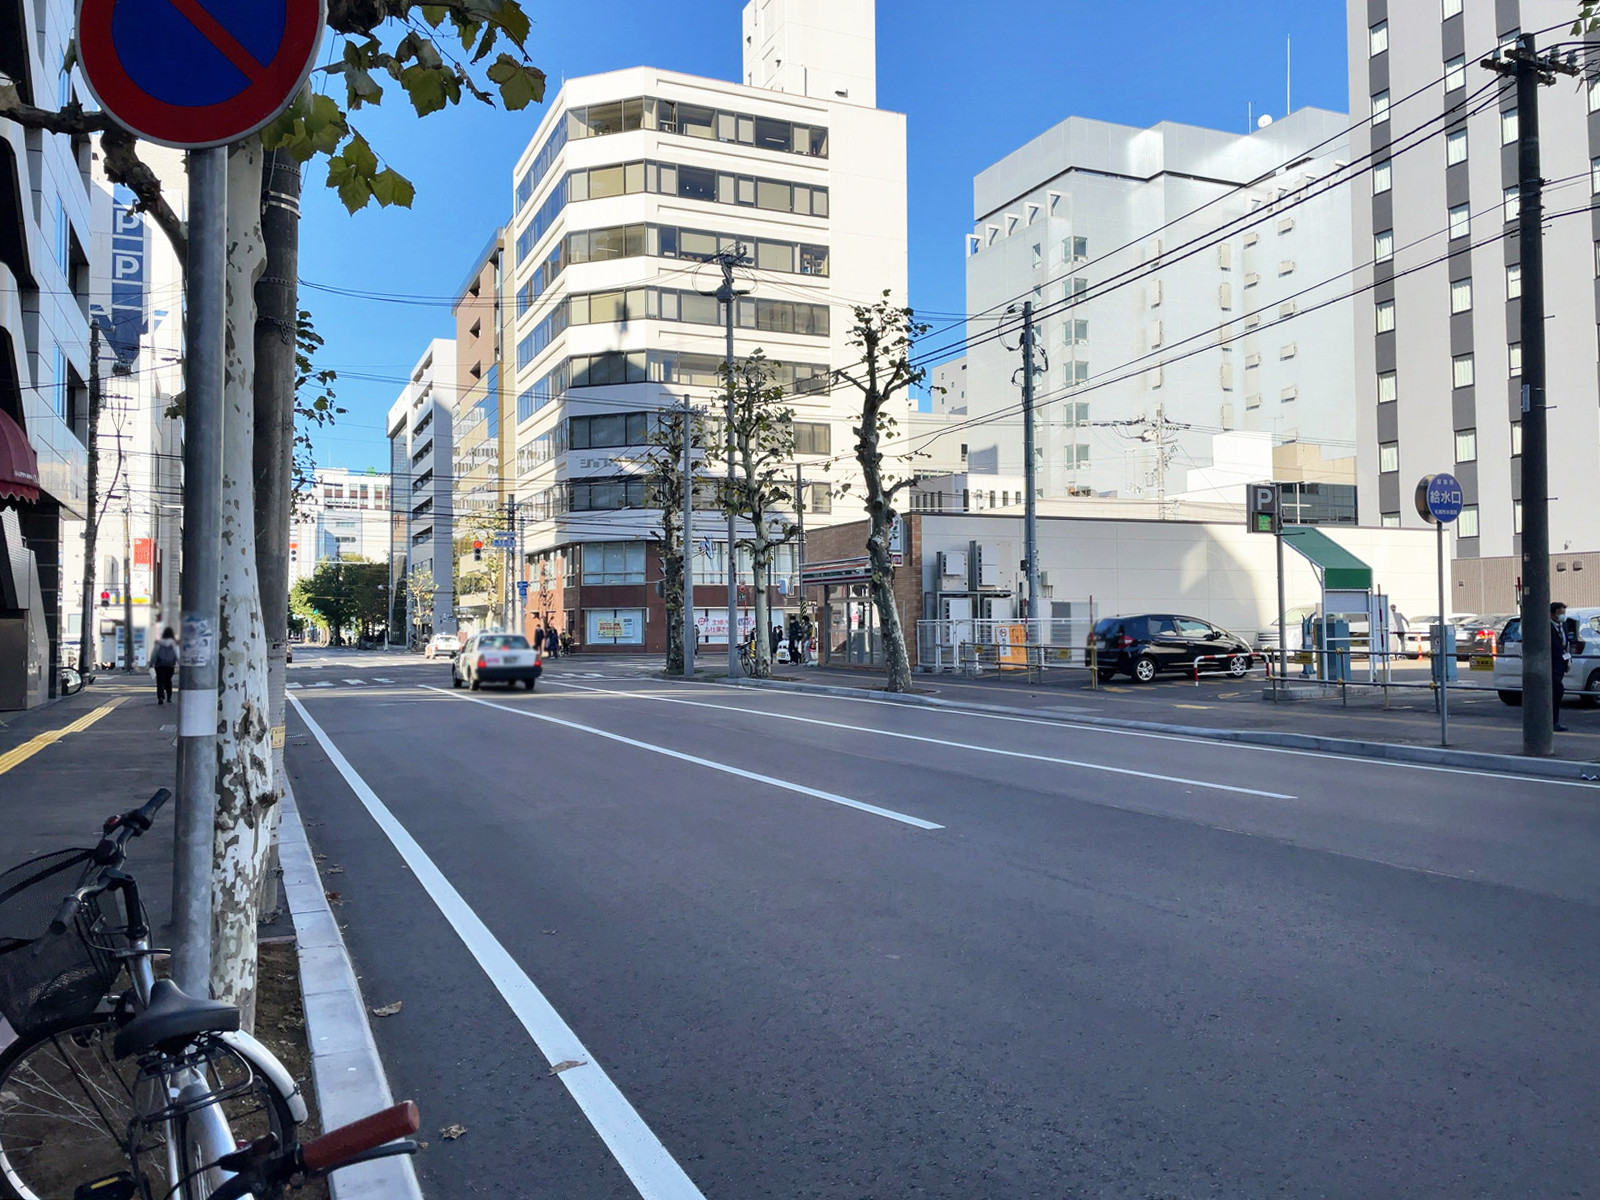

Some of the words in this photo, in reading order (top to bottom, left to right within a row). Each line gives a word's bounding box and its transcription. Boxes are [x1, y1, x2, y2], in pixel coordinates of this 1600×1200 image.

[117, 210, 139, 233] P
[115, 255, 139, 278] P
[1257, 488, 1273, 510] P
[1430, 490, 1461, 504] 給水口
